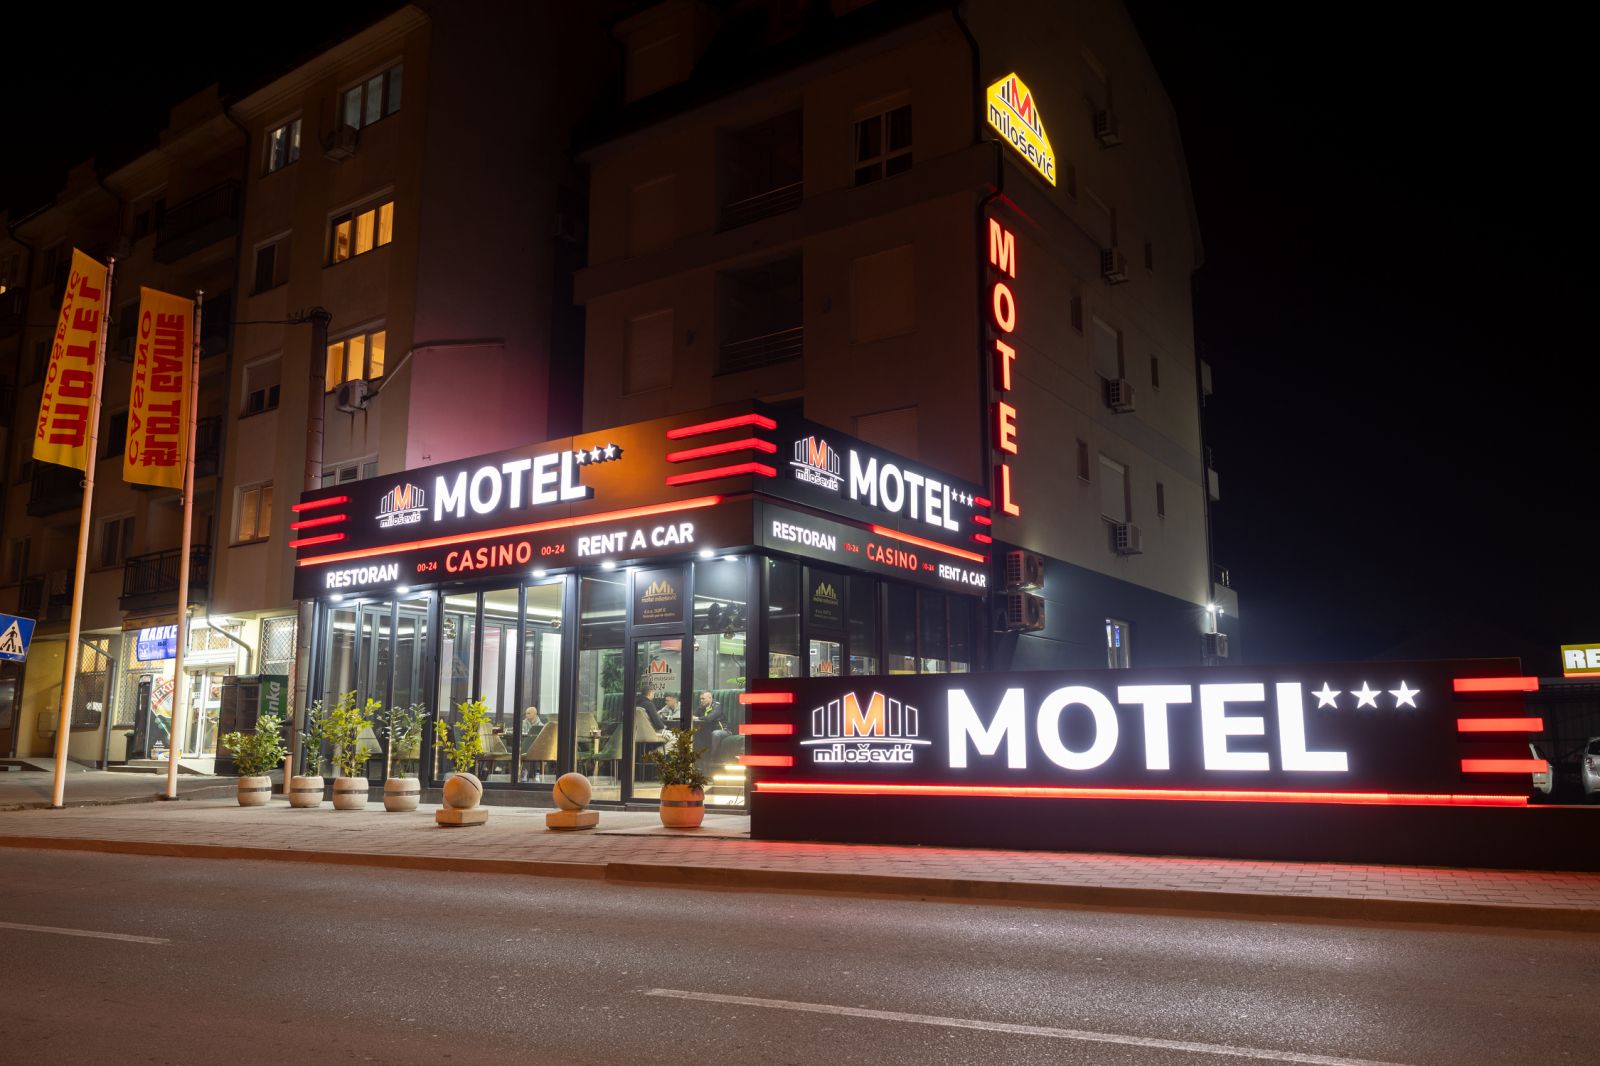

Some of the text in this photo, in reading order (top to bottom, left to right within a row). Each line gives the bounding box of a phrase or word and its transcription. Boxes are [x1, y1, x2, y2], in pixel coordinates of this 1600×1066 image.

[990, 103, 1054, 181] milošević
[989, 217, 1020, 517] MOTEL
[434, 452, 588, 522] MOTEL
[795, 468, 839, 491] milošević
[849, 449, 960, 532] MOTEL
[379, 511, 421, 528] milošević
[326, 523, 694, 589] RESTORAN 00-24 CASINO 00-24 RENT A CAR
[772, 520, 837, 552] RESTORAN
[866, 543, 918, 571] CASINO
[938, 564, 960, 582] RENT
[961, 570, 969, 583] A
[969, 571, 986, 588] CAR
[140, 624, 178, 642] MARKE
[1564, 649, 1600, 669] RE
[812, 744, 915, 765] milošević
[946, 682, 1350, 774] MOTEL
